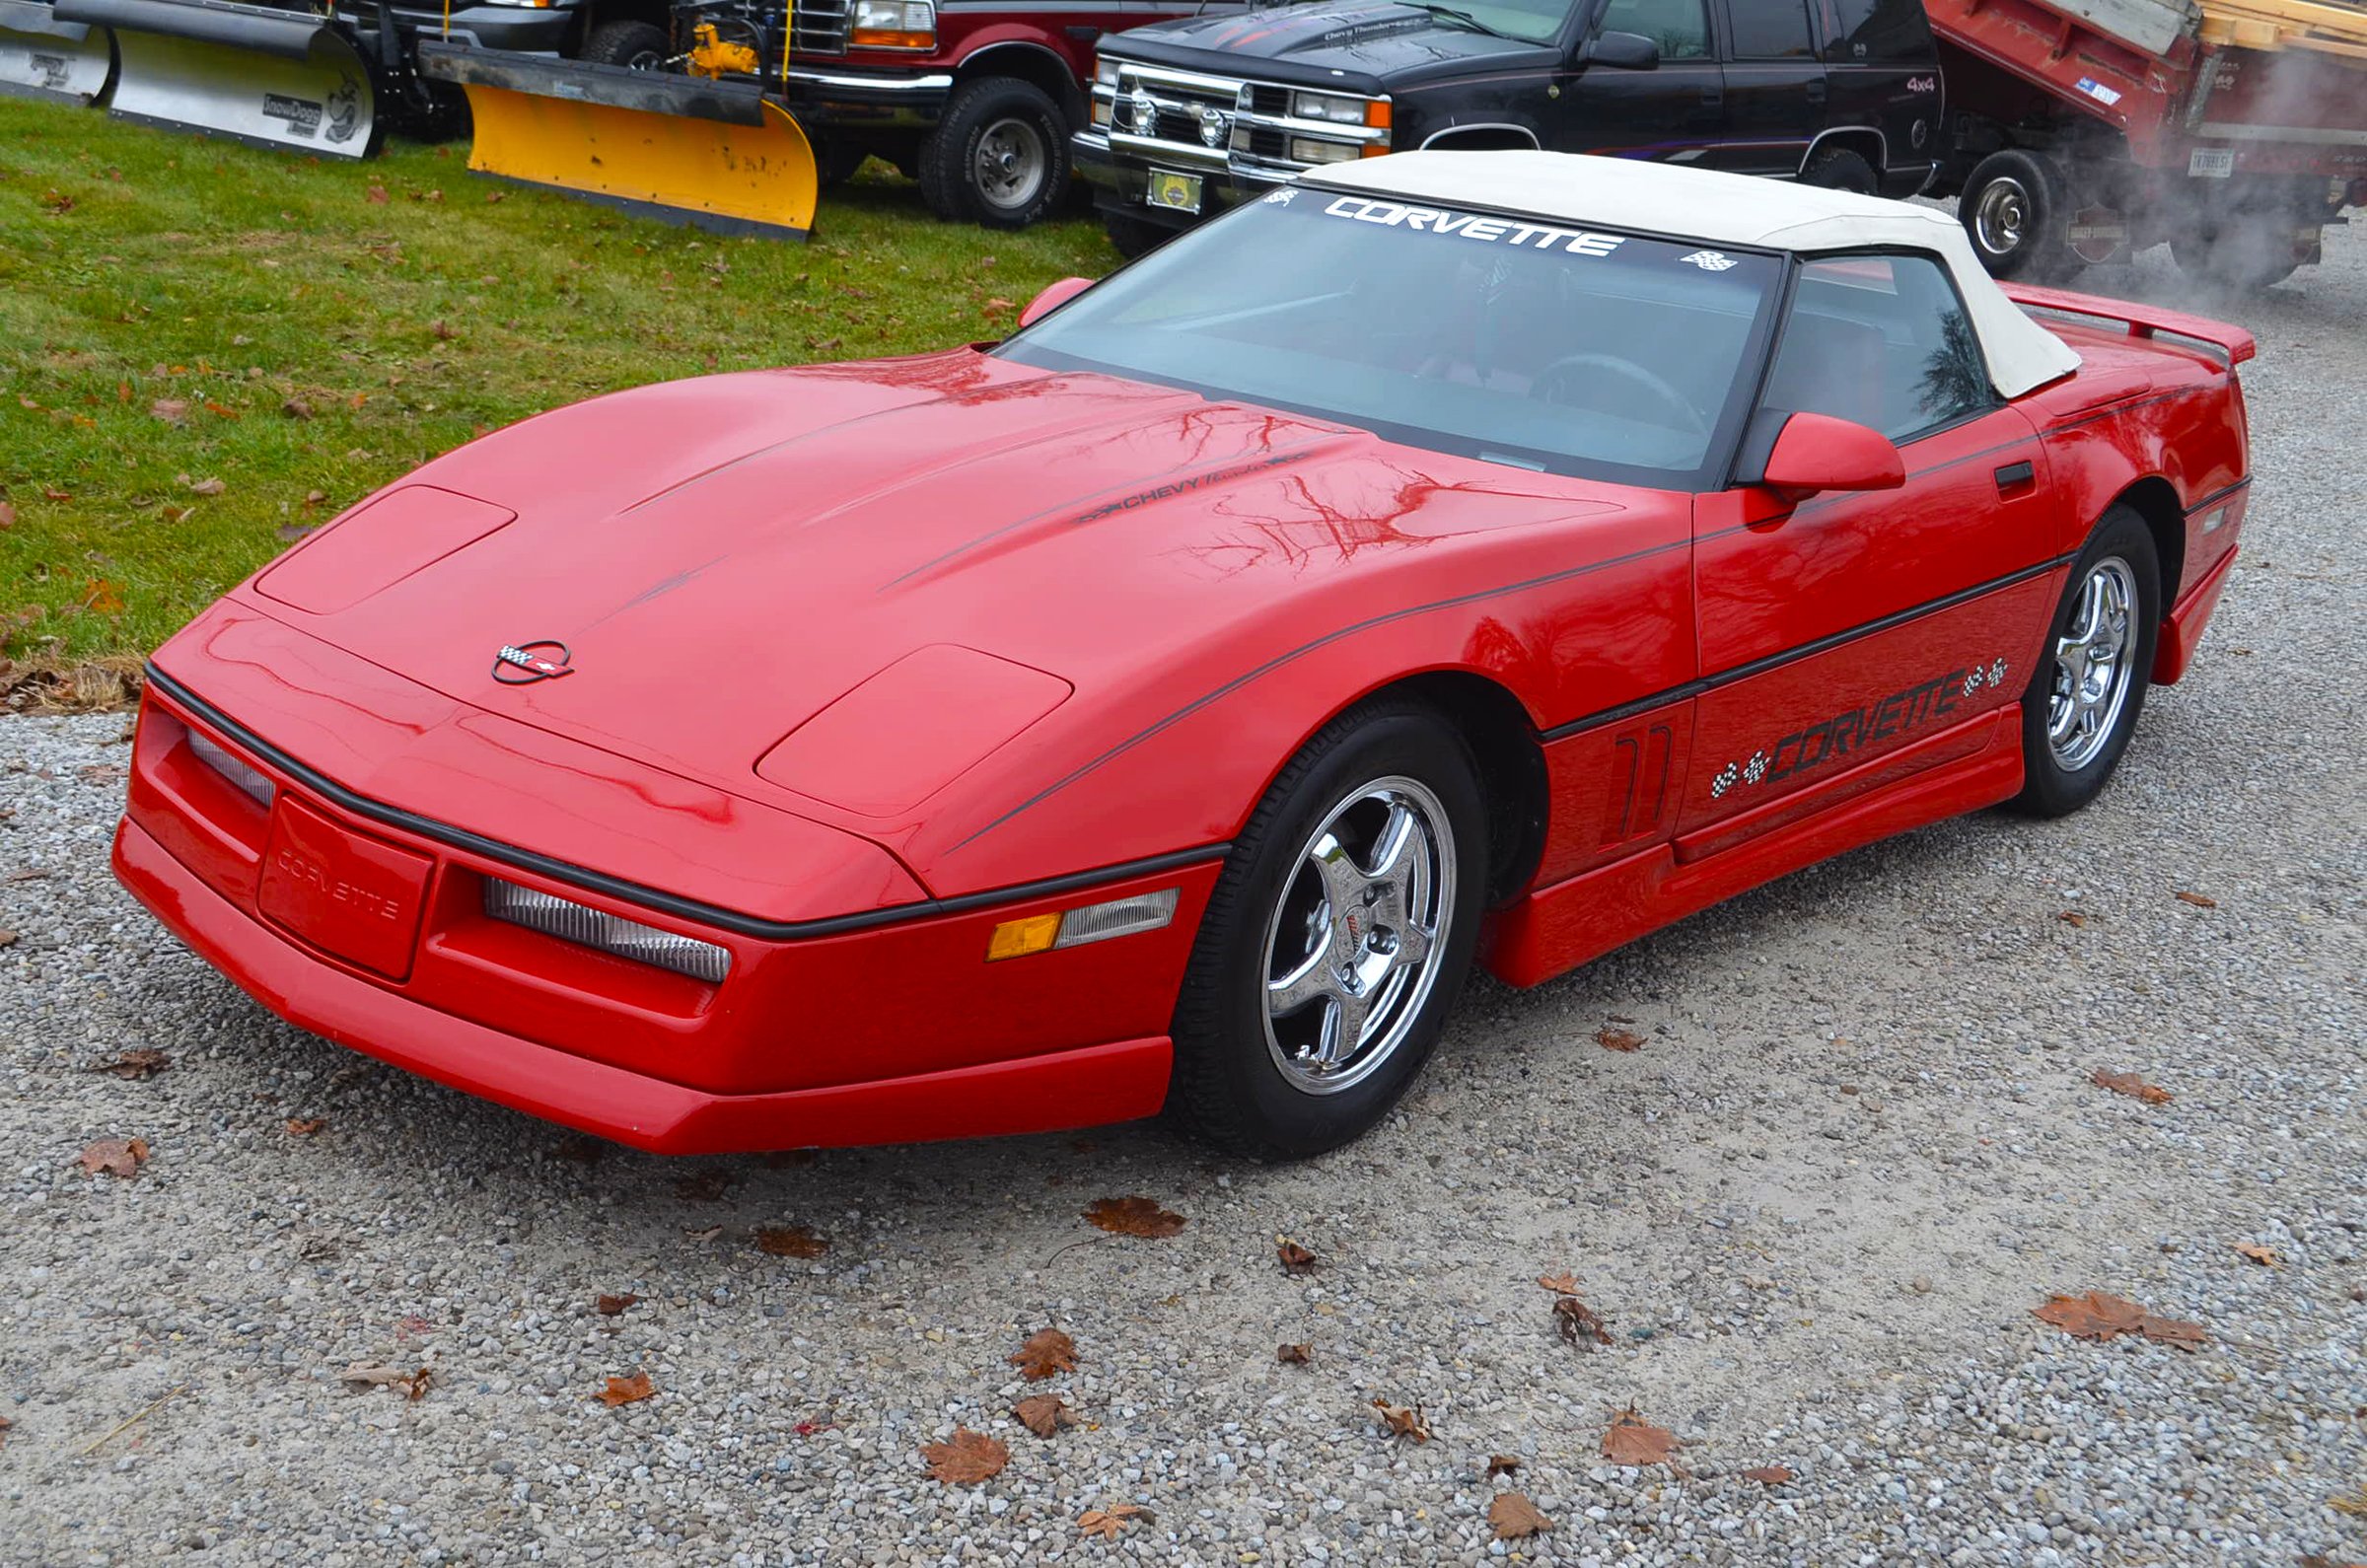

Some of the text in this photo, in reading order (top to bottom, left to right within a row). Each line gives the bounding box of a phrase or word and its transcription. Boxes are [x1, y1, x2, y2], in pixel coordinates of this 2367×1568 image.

[1906, 77, 1935, 92] 4x4
[1324, 196, 1626, 257] CORVETTE
[1123, 477, 1199, 510] CHEVY
[1765, 668, 1967, 785] CORVETTE
[277, 849, 399, 920] CORVETTE
